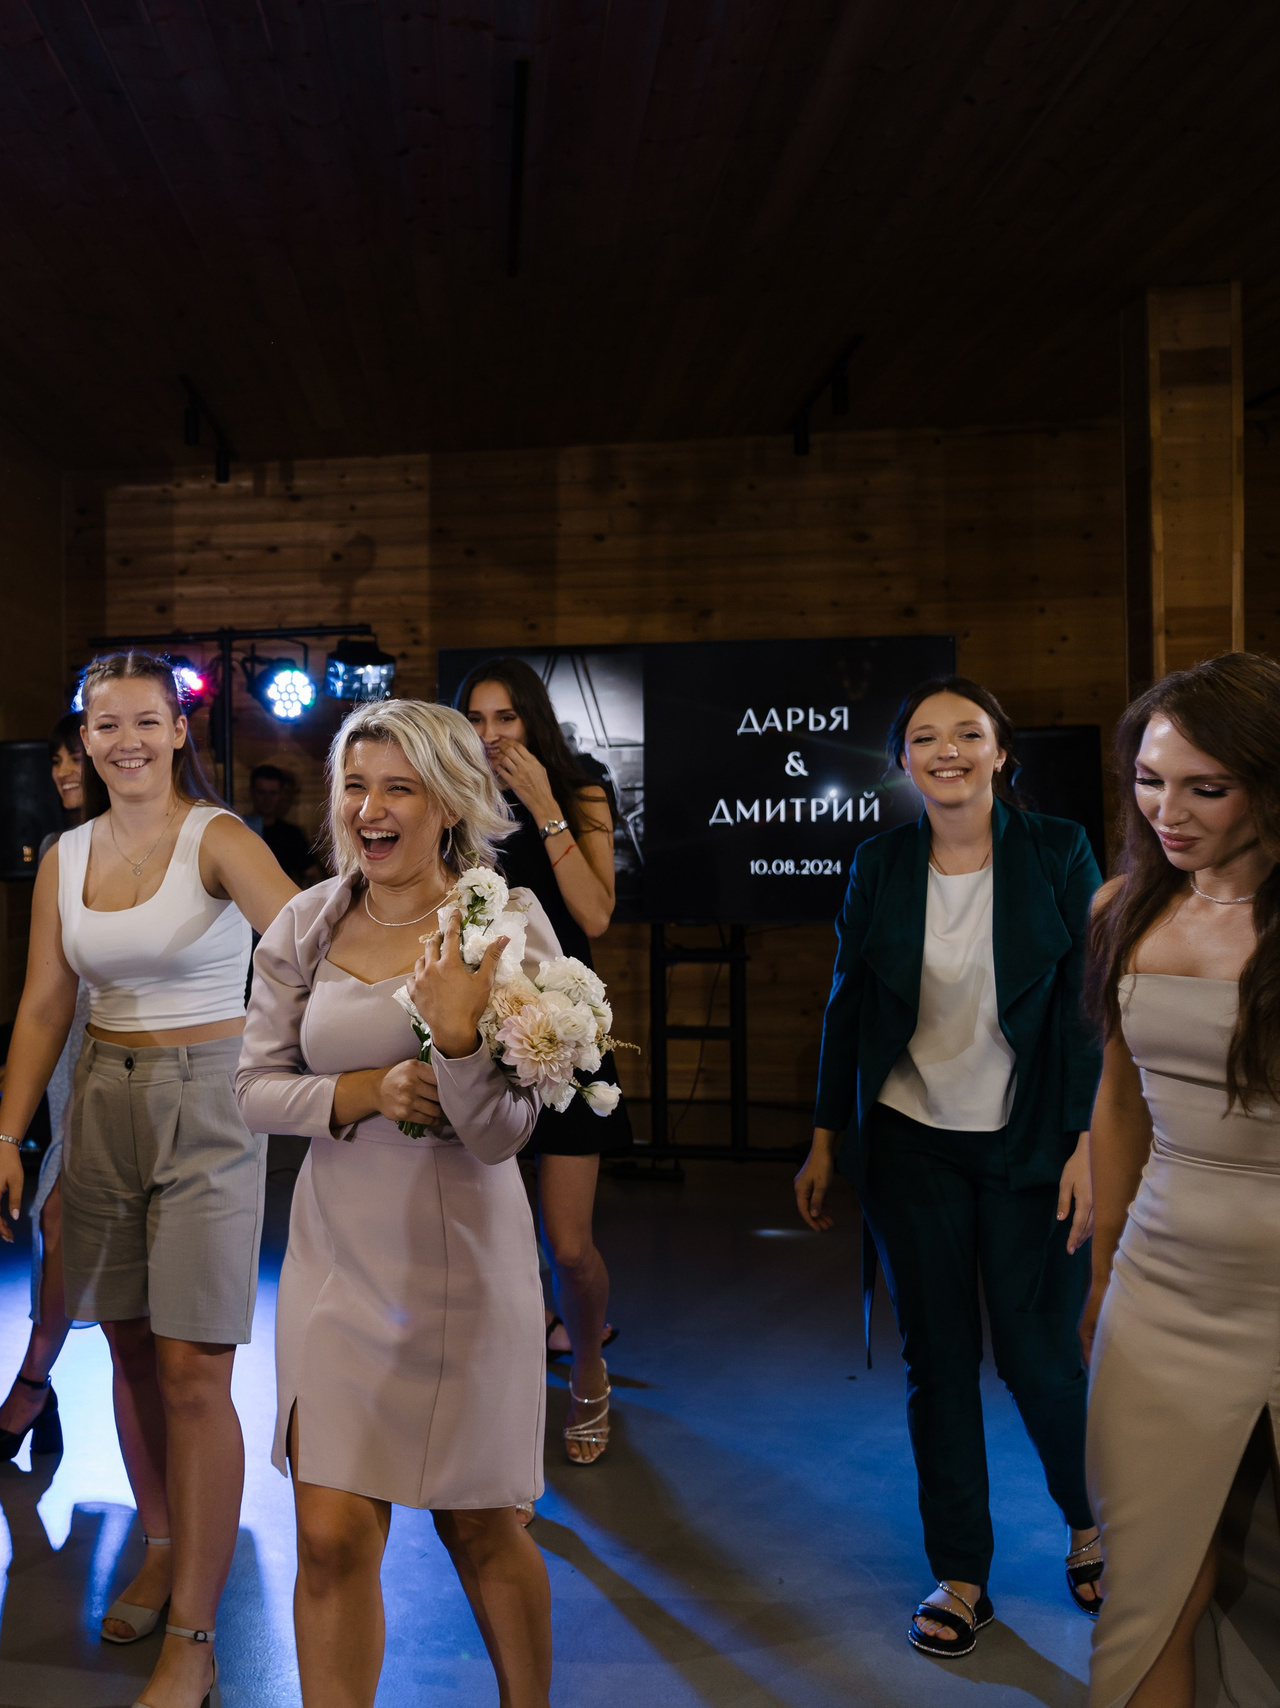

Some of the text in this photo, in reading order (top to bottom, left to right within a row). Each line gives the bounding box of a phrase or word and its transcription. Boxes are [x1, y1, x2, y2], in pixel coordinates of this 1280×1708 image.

[736, 706, 850, 736] ДАРЬЯ
[784, 751, 809, 777] &
[708, 790, 881, 826] ДМИТРИЙ
[749, 858, 842, 876] 10.08.2024
